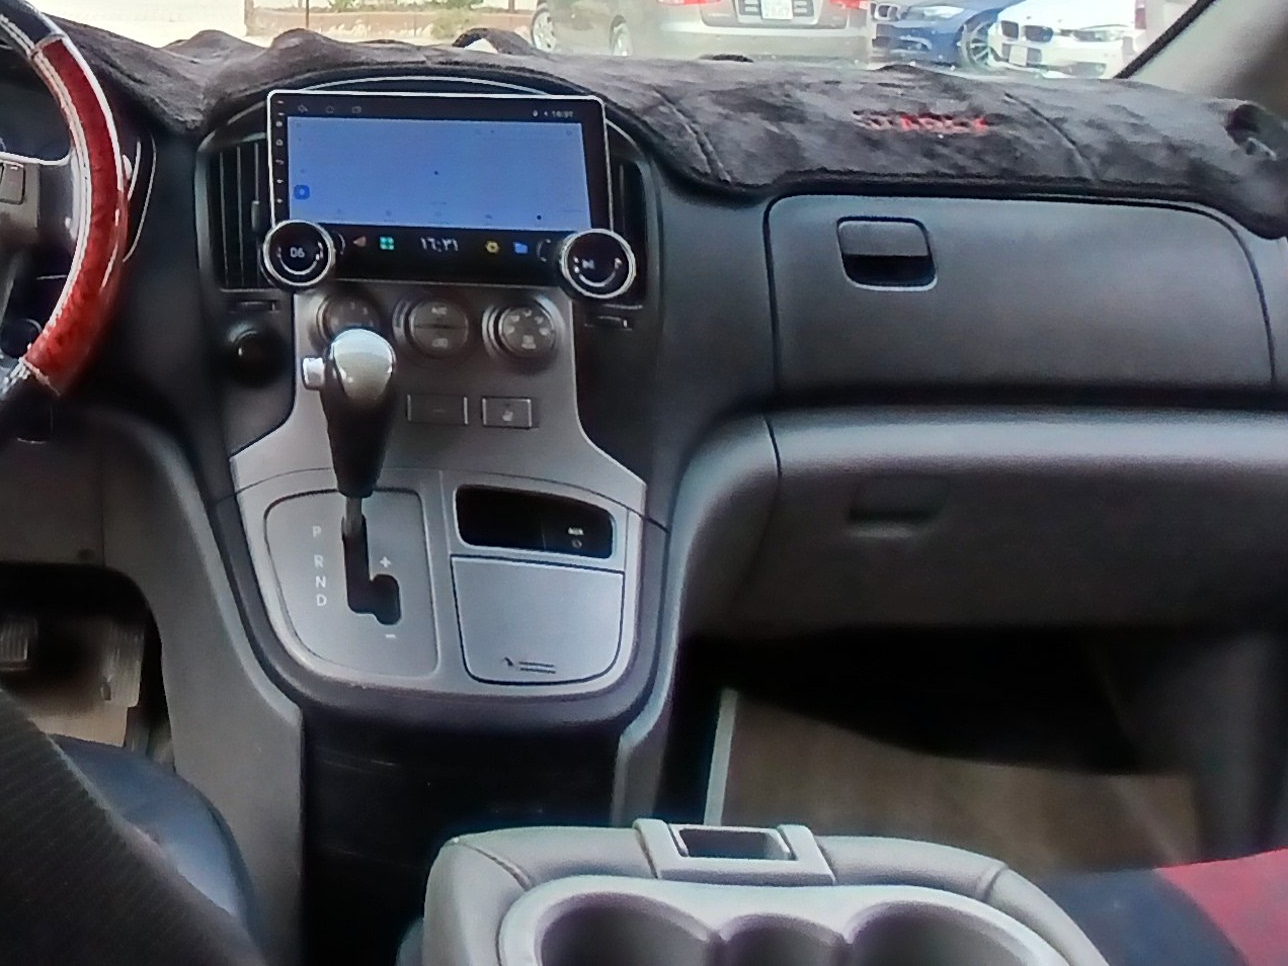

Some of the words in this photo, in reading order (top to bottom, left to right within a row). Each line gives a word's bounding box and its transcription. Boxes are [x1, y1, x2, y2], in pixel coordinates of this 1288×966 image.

[313, 554, 324, 568] R
[315, 575, 327, 588] N
[316, 594, 327, 607] D
